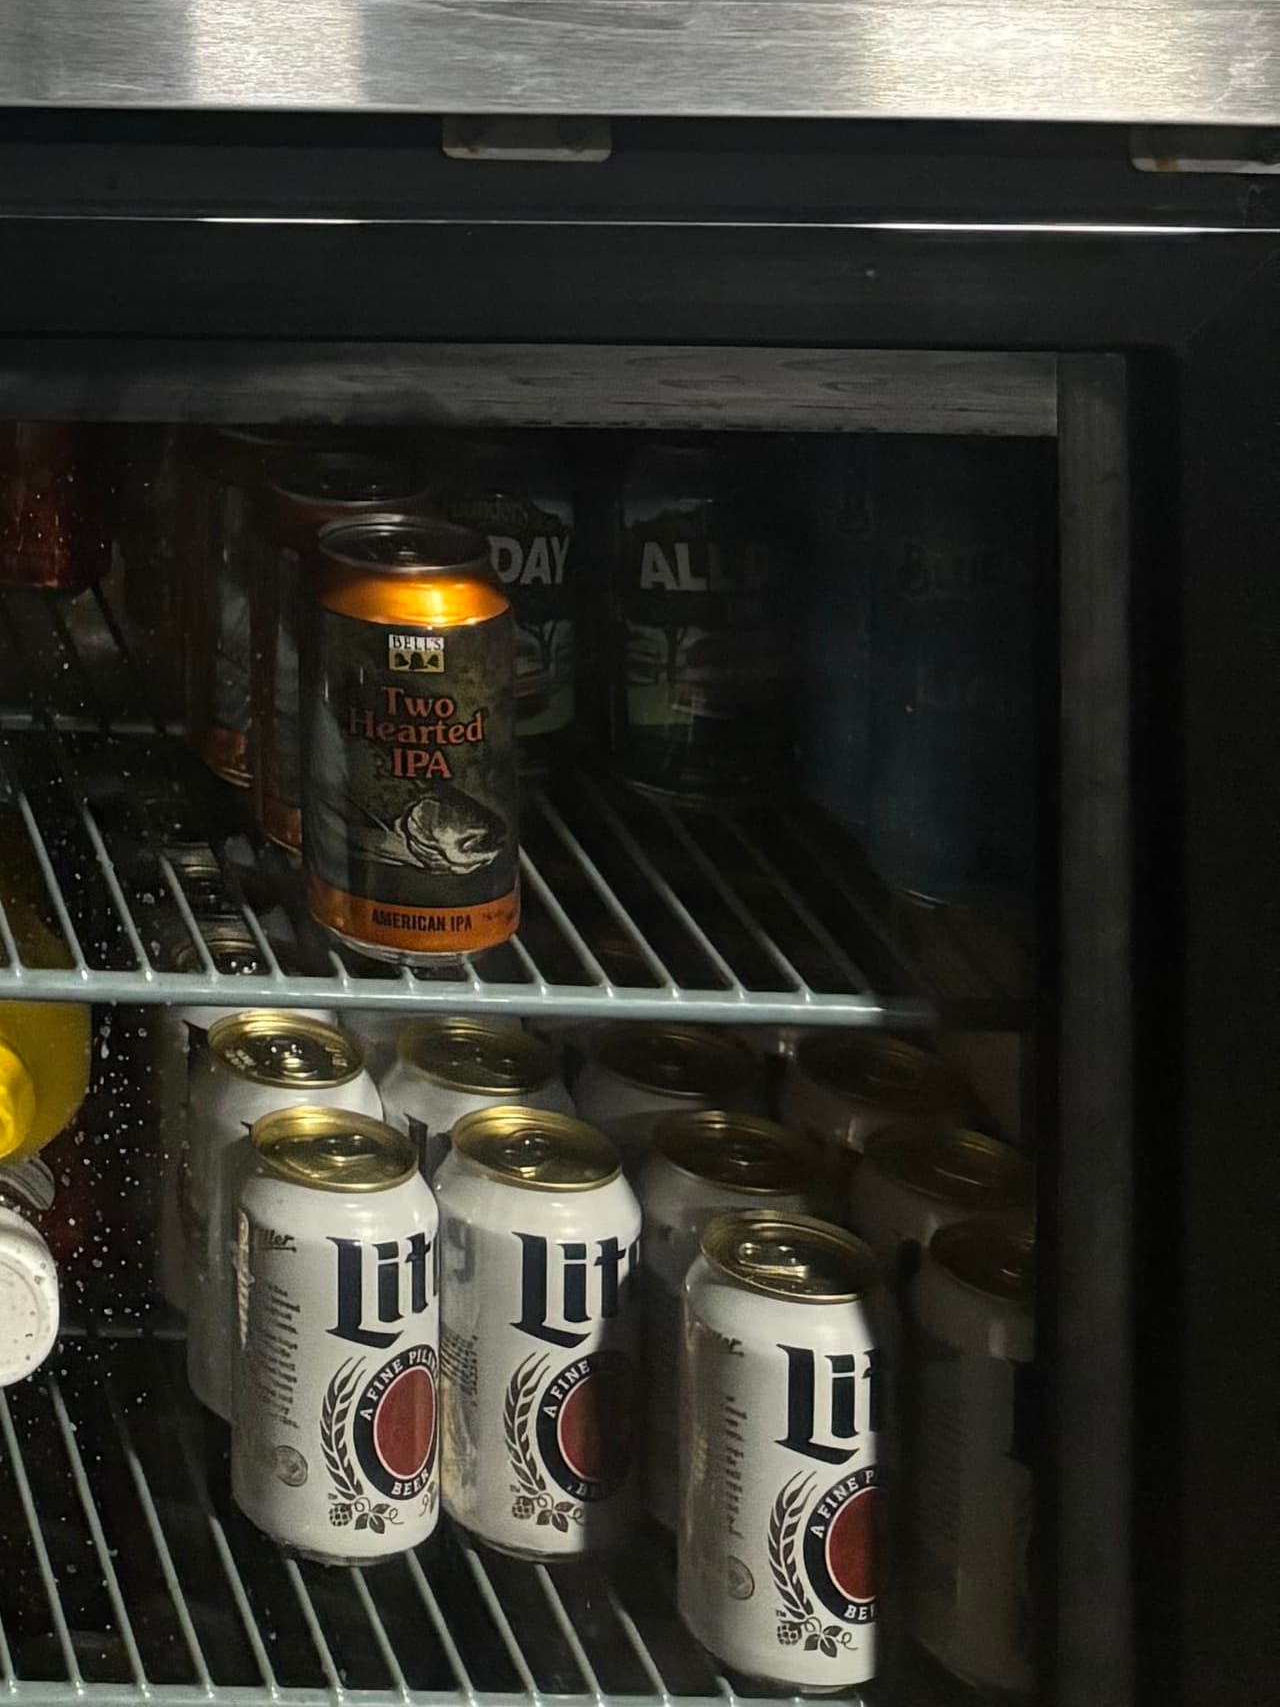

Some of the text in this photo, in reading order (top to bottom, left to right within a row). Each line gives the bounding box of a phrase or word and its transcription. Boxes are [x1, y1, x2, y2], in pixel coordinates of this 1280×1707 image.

[489, 535, 572, 585] DAY
[382, 688, 454, 721] Two
[347, 708, 484, 746] Hearted
[390, 748, 452, 780] IPA
[371, 908, 473, 934] AMERICAN IPA
[325, 1230, 438, 1349] Lit
[359, 1357, 405, 1422] A FINE
[542, 1359, 591, 1419] A FINE
[390, 1469, 431, 1497] BEER
[810, 1476, 859, 1540] A FINE
